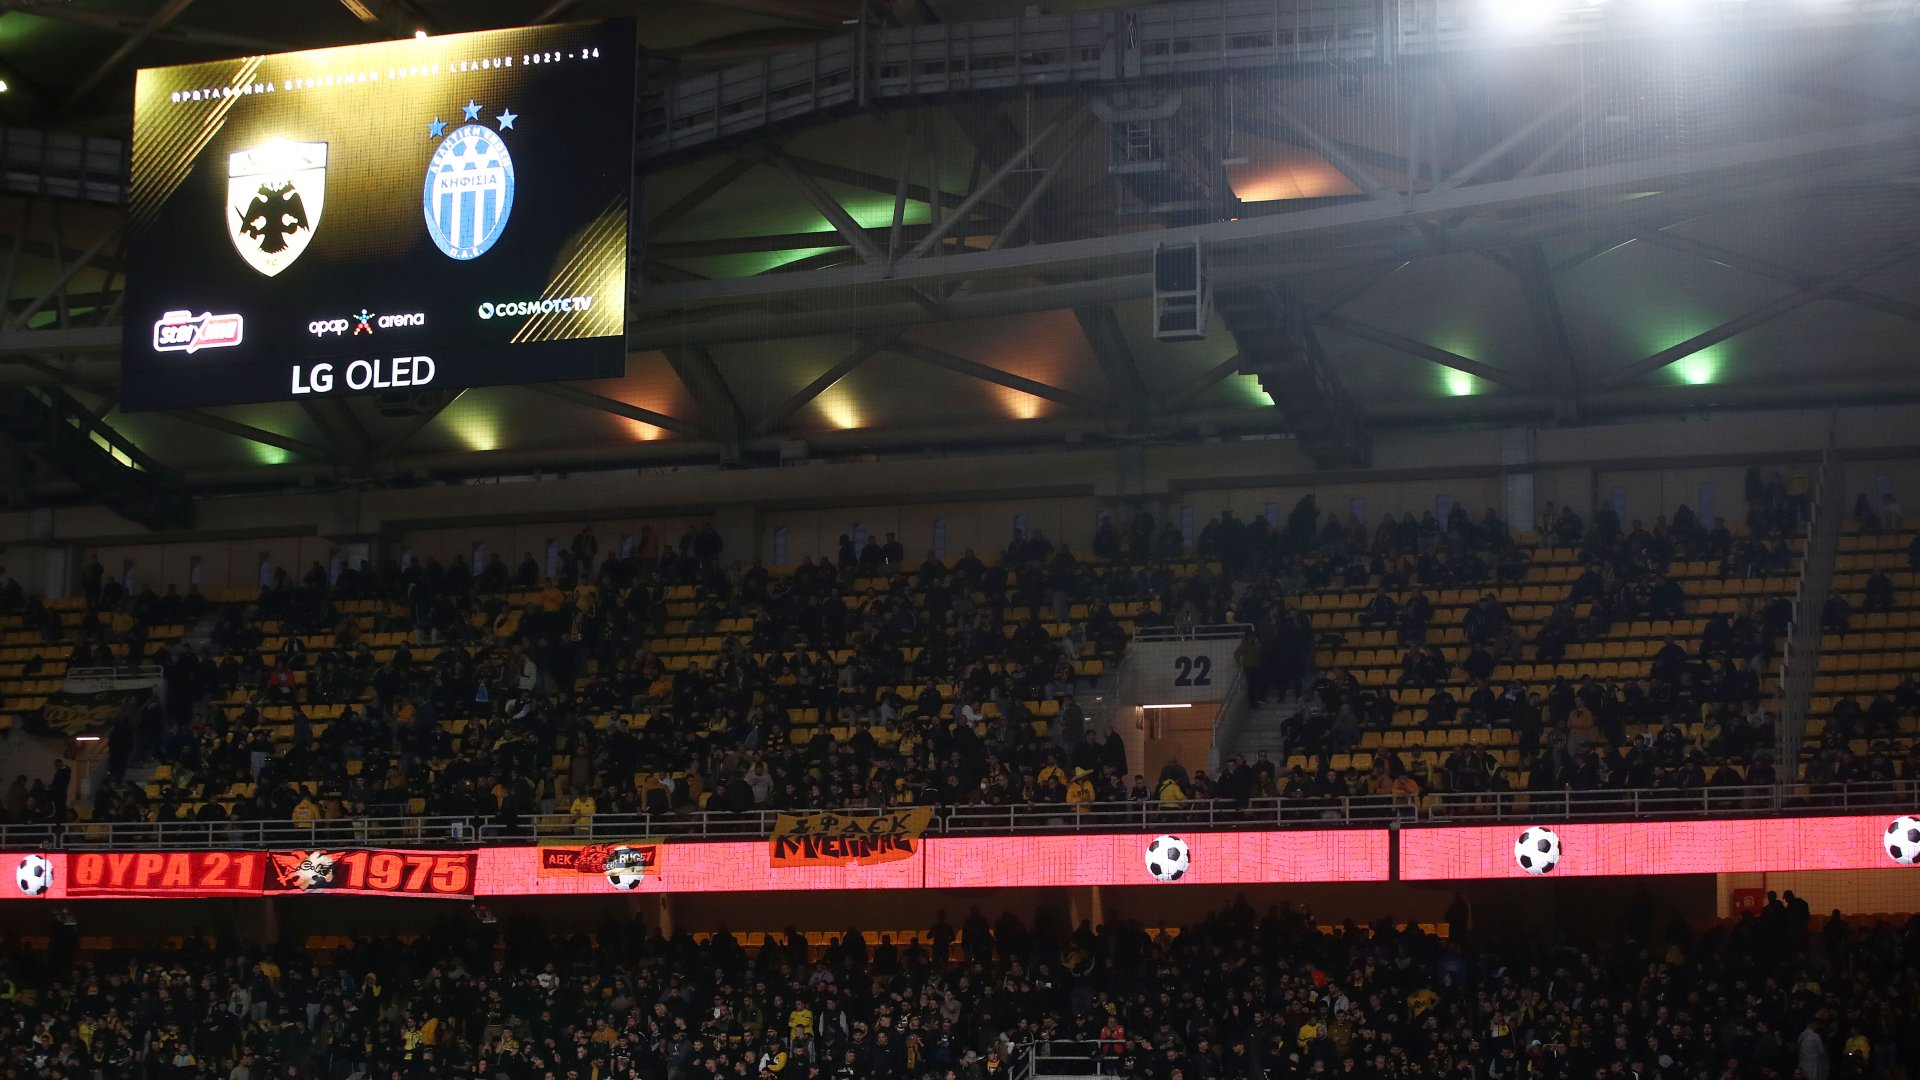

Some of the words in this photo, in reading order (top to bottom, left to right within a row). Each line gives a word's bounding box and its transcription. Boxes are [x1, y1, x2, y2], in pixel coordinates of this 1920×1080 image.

[450, 56, 513, 73] LEAGUE
[523, 51, 561, 66] 2023
[582, 48, 600, 60] 24
[441, 173, 498, 189] ΚΗΦΙΣΙΑ
[308, 318, 350, 338] opap
[377, 312, 426, 329] arena
[291, 362, 334, 394] LG
[345, 355, 436, 391] OLED
[1174, 655, 1212, 687] 22
[199, 852, 255, 887] 21
[341, 850, 470, 894] 1975
[548, 853, 574, 866] AEK
